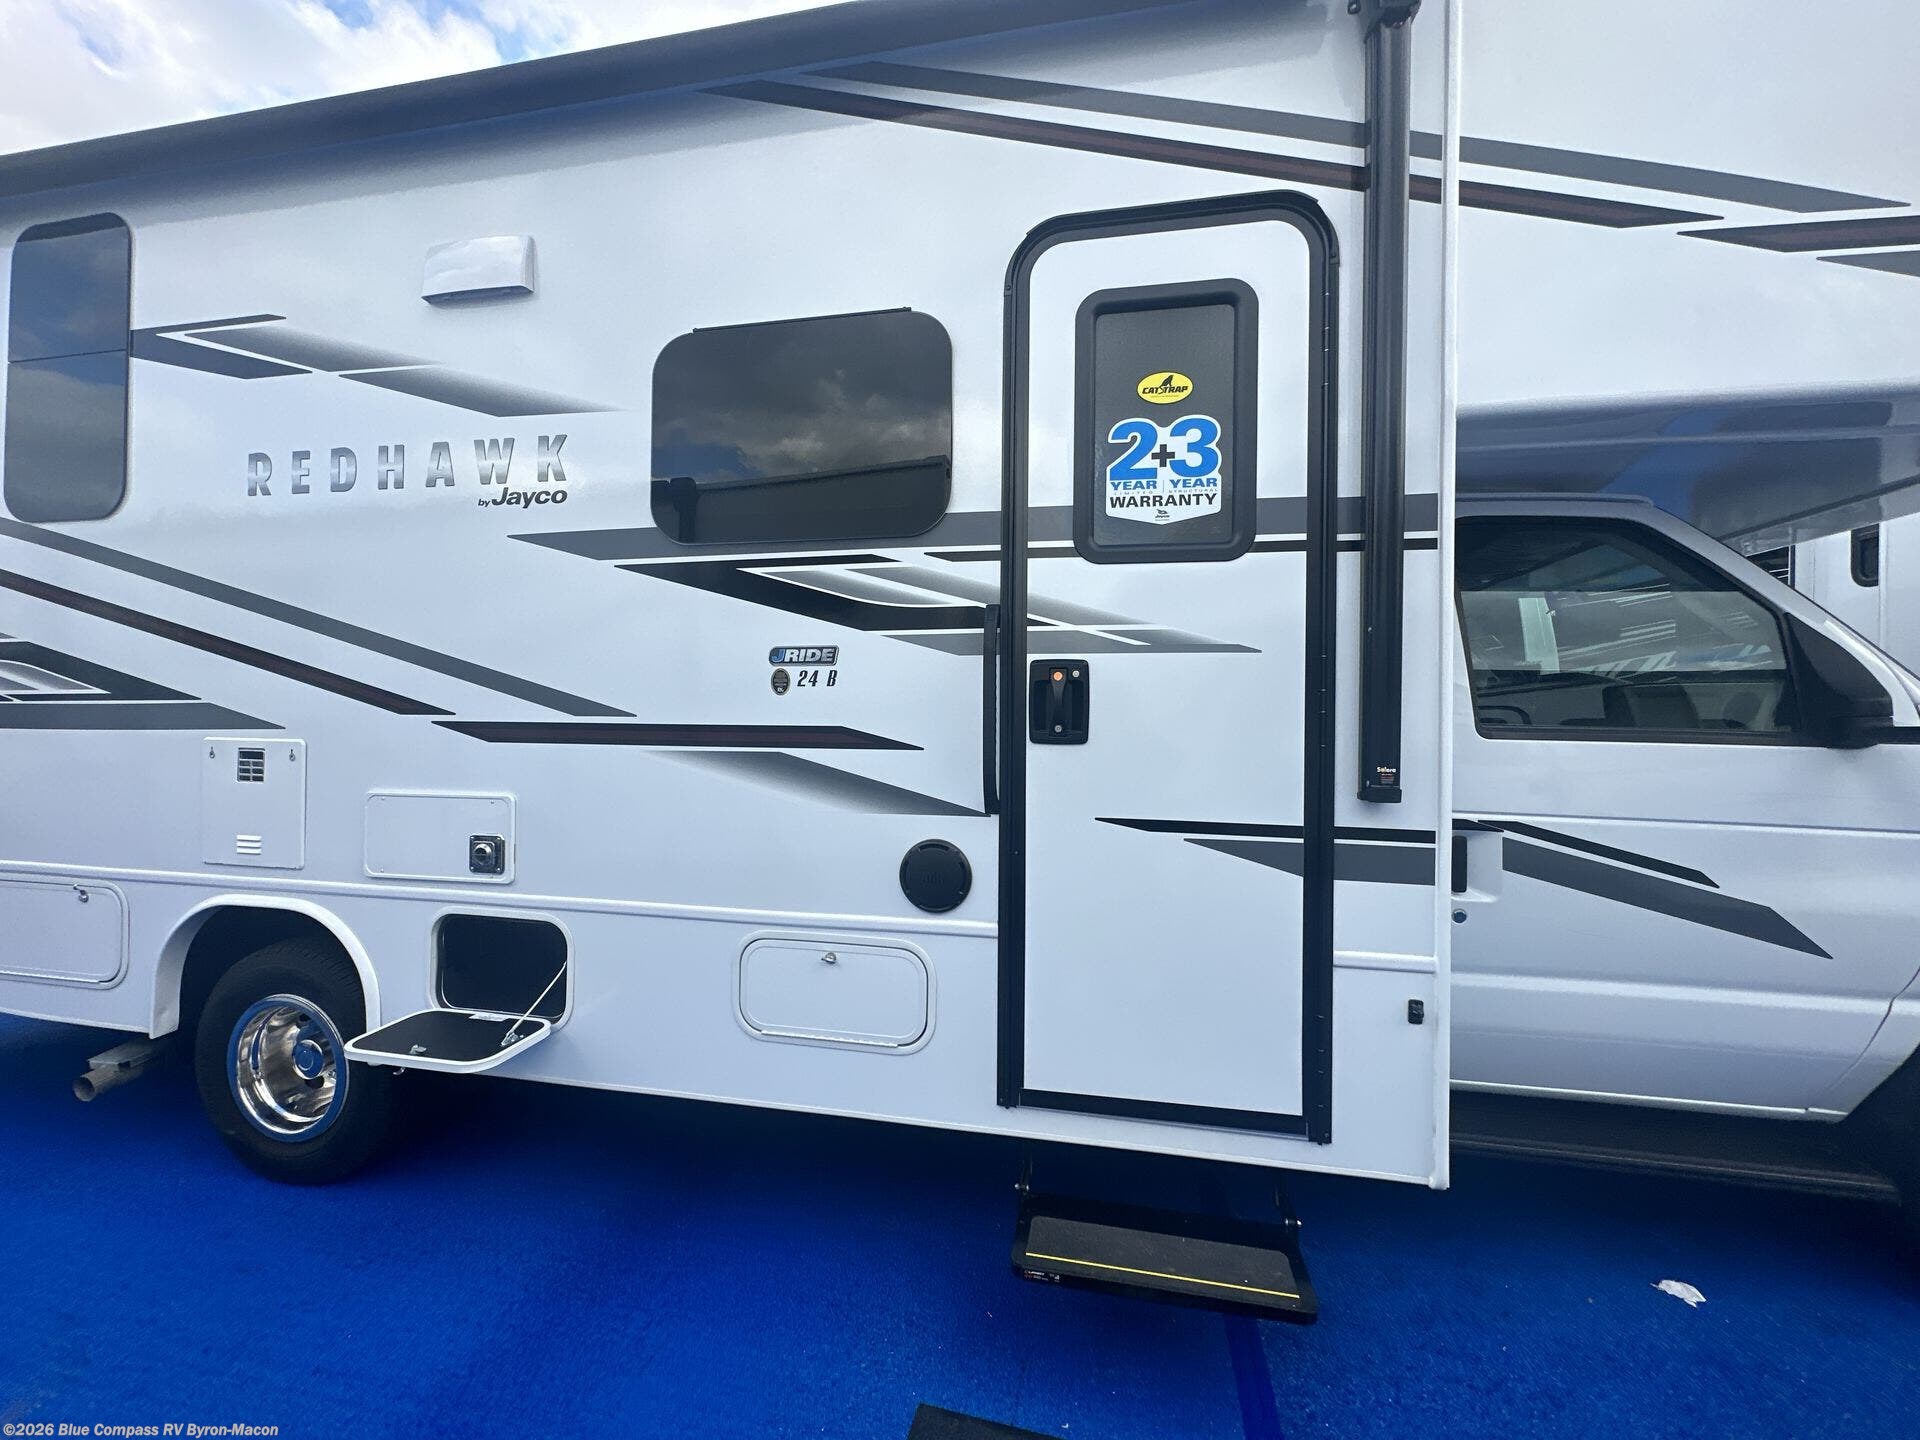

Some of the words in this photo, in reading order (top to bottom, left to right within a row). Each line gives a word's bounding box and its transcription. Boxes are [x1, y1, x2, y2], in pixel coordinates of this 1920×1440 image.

[247, 433, 568, 497] REDHAWK
[1111, 480, 1158, 491] YEAR
[1169, 477, 1218, 488] YEAR
[478, 498, 490, 508] by
[491, 487, 568, 509] Jayco
[1109, 493, 1218, 509] WARRANTY
[771, 648, 835, 663] JRIDE
[797, 669, 819, 687] 24
[826, 669, 838, 687] B
